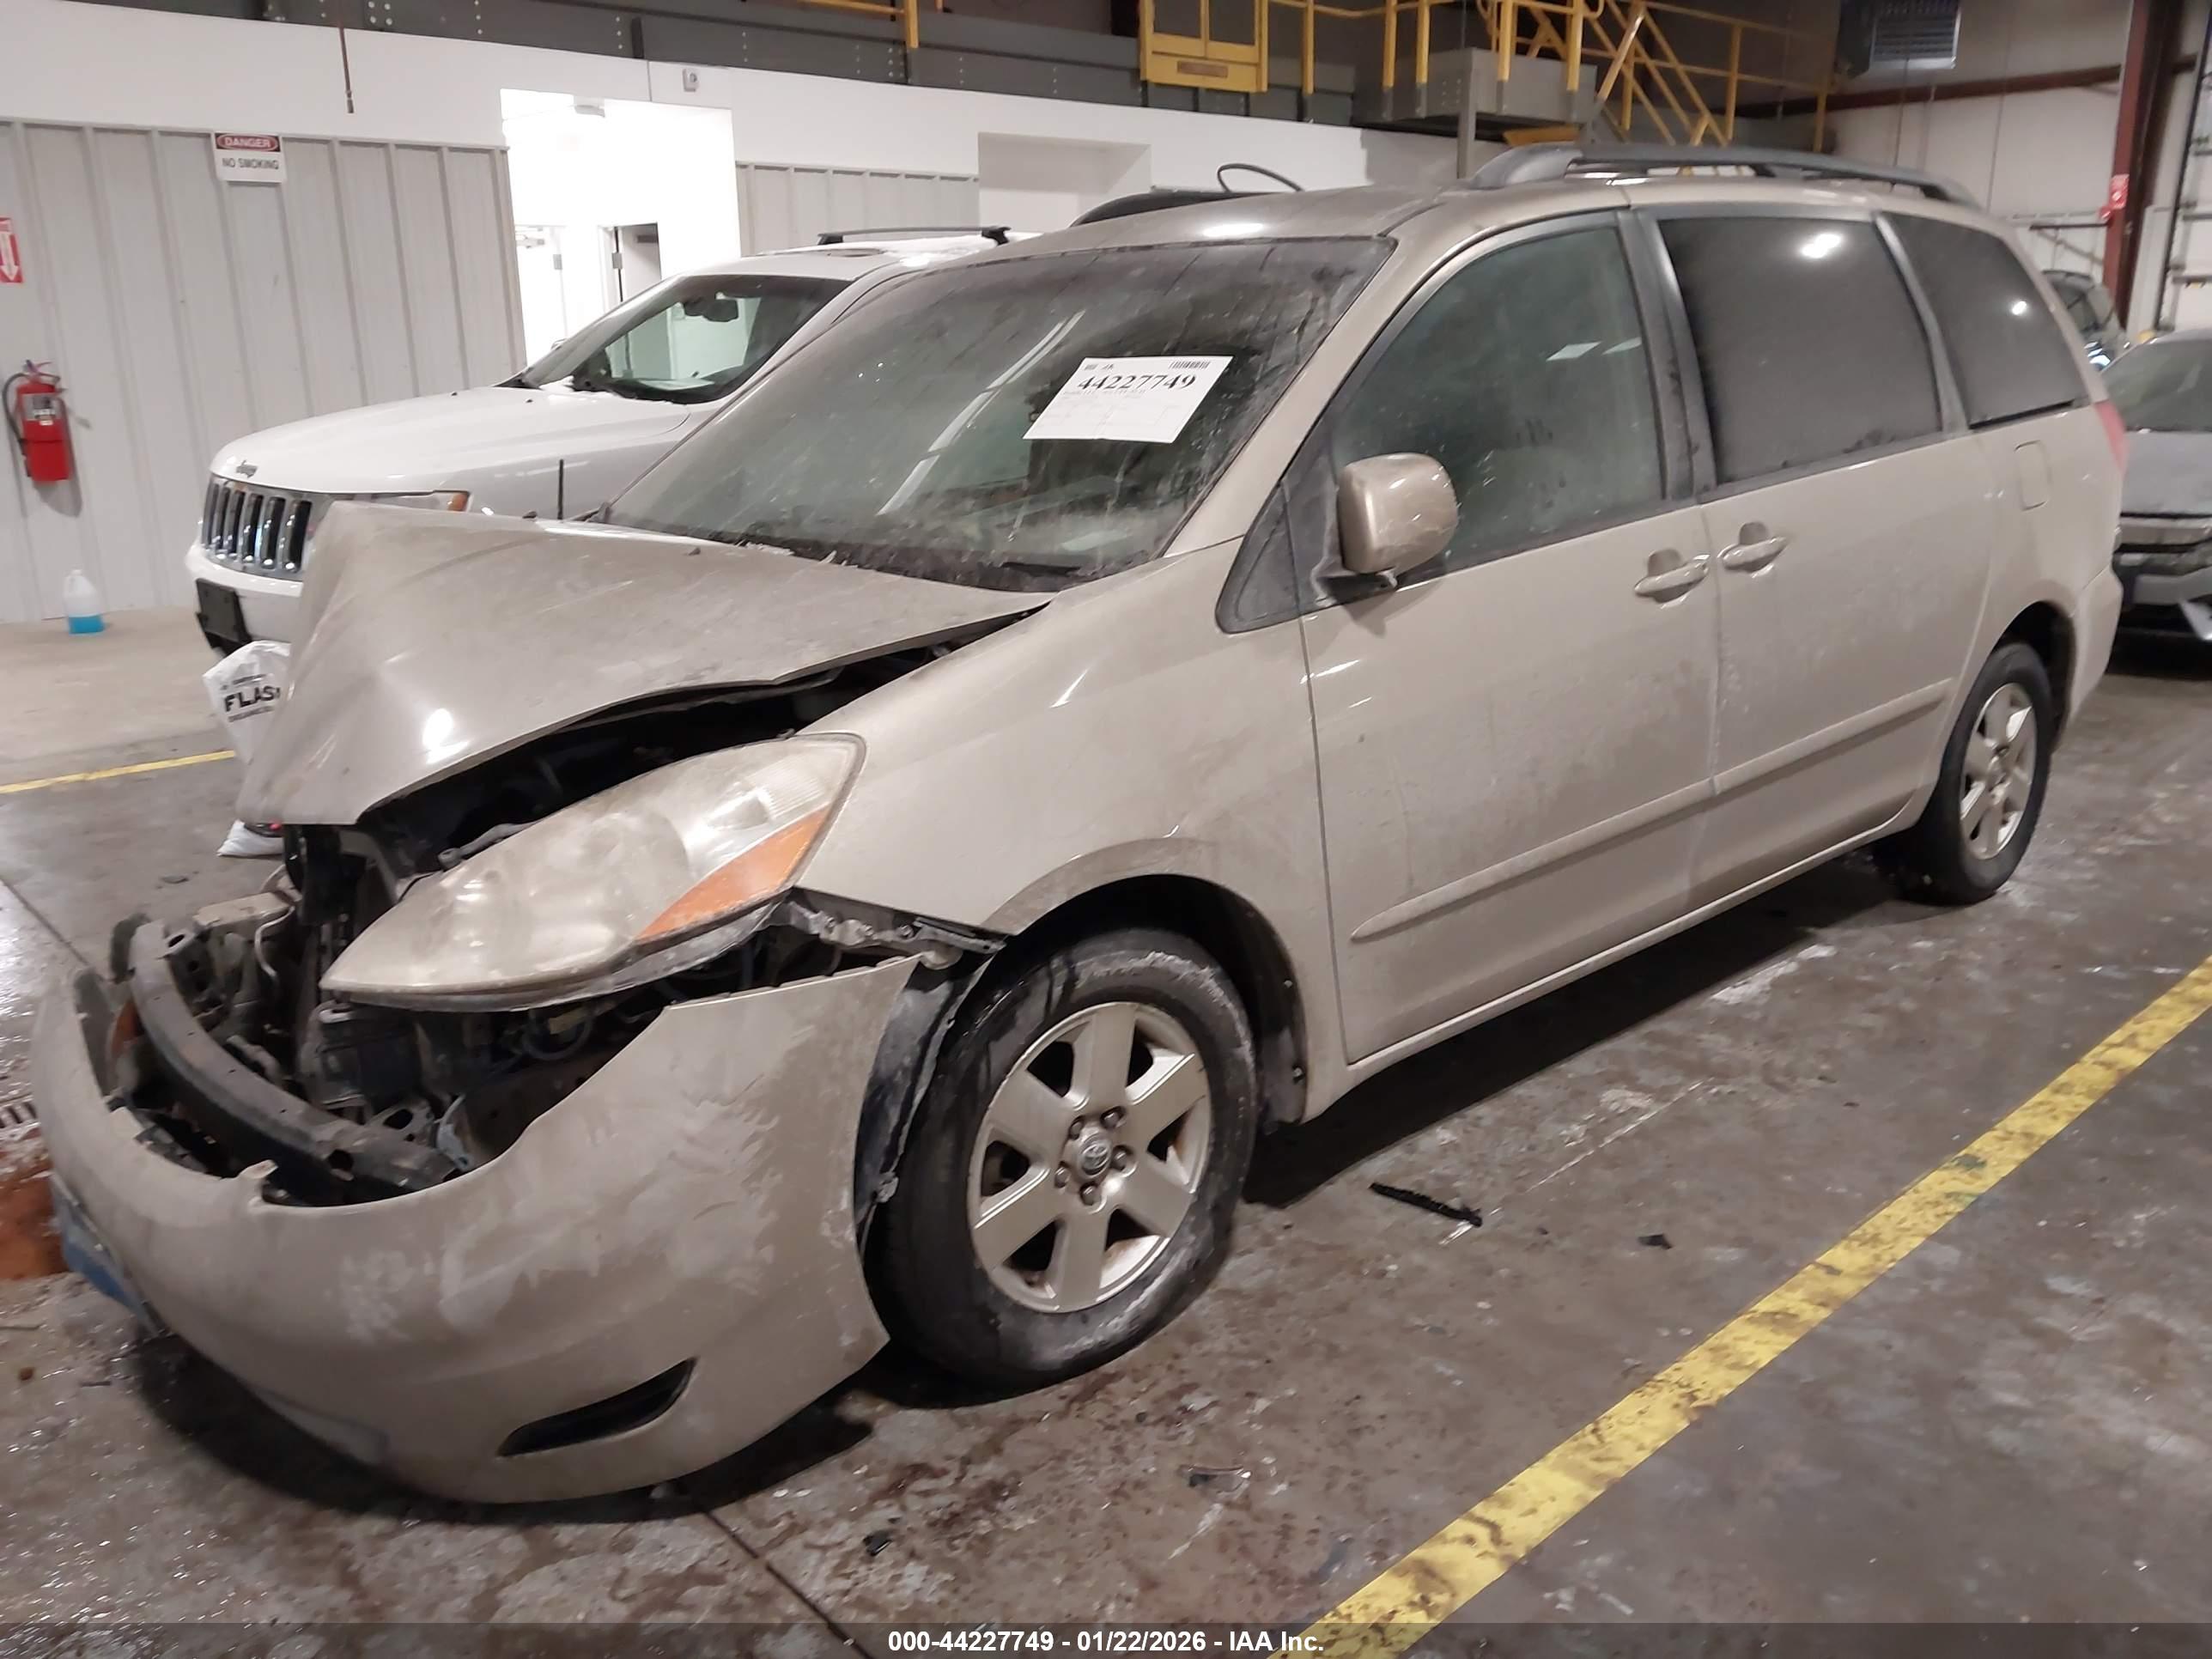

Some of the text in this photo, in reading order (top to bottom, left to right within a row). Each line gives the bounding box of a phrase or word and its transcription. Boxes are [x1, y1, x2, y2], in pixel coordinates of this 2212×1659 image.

[224, 137, 271, 148] DANGER
[222, 157, 279, 169] NO SMOKING
[1077, 374, 1197, 391] 44227749
